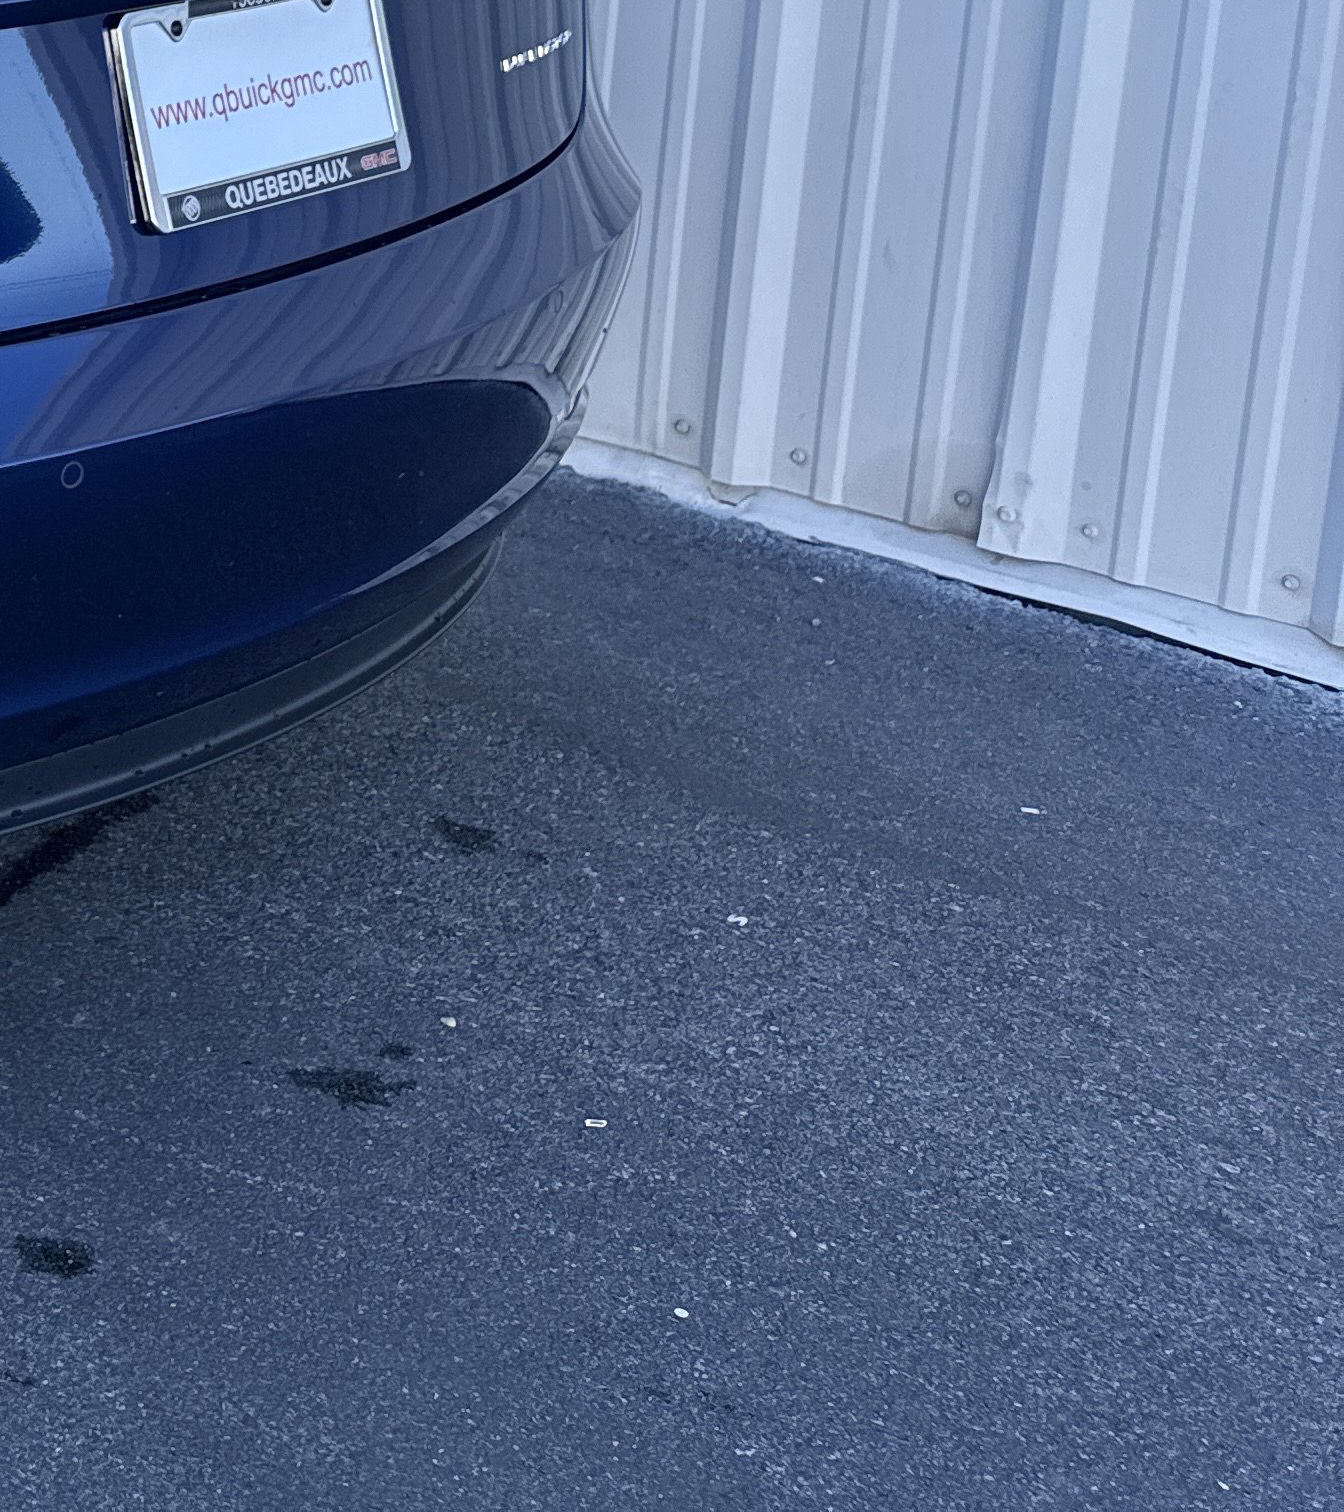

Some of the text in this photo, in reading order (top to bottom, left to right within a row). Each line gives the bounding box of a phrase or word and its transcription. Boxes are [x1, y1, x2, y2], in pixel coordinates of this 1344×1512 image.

[150, 59, 373, 130] www.qbuickgmc.com
[225, 148, 398, 209] QUEBEDEAUX GMC
